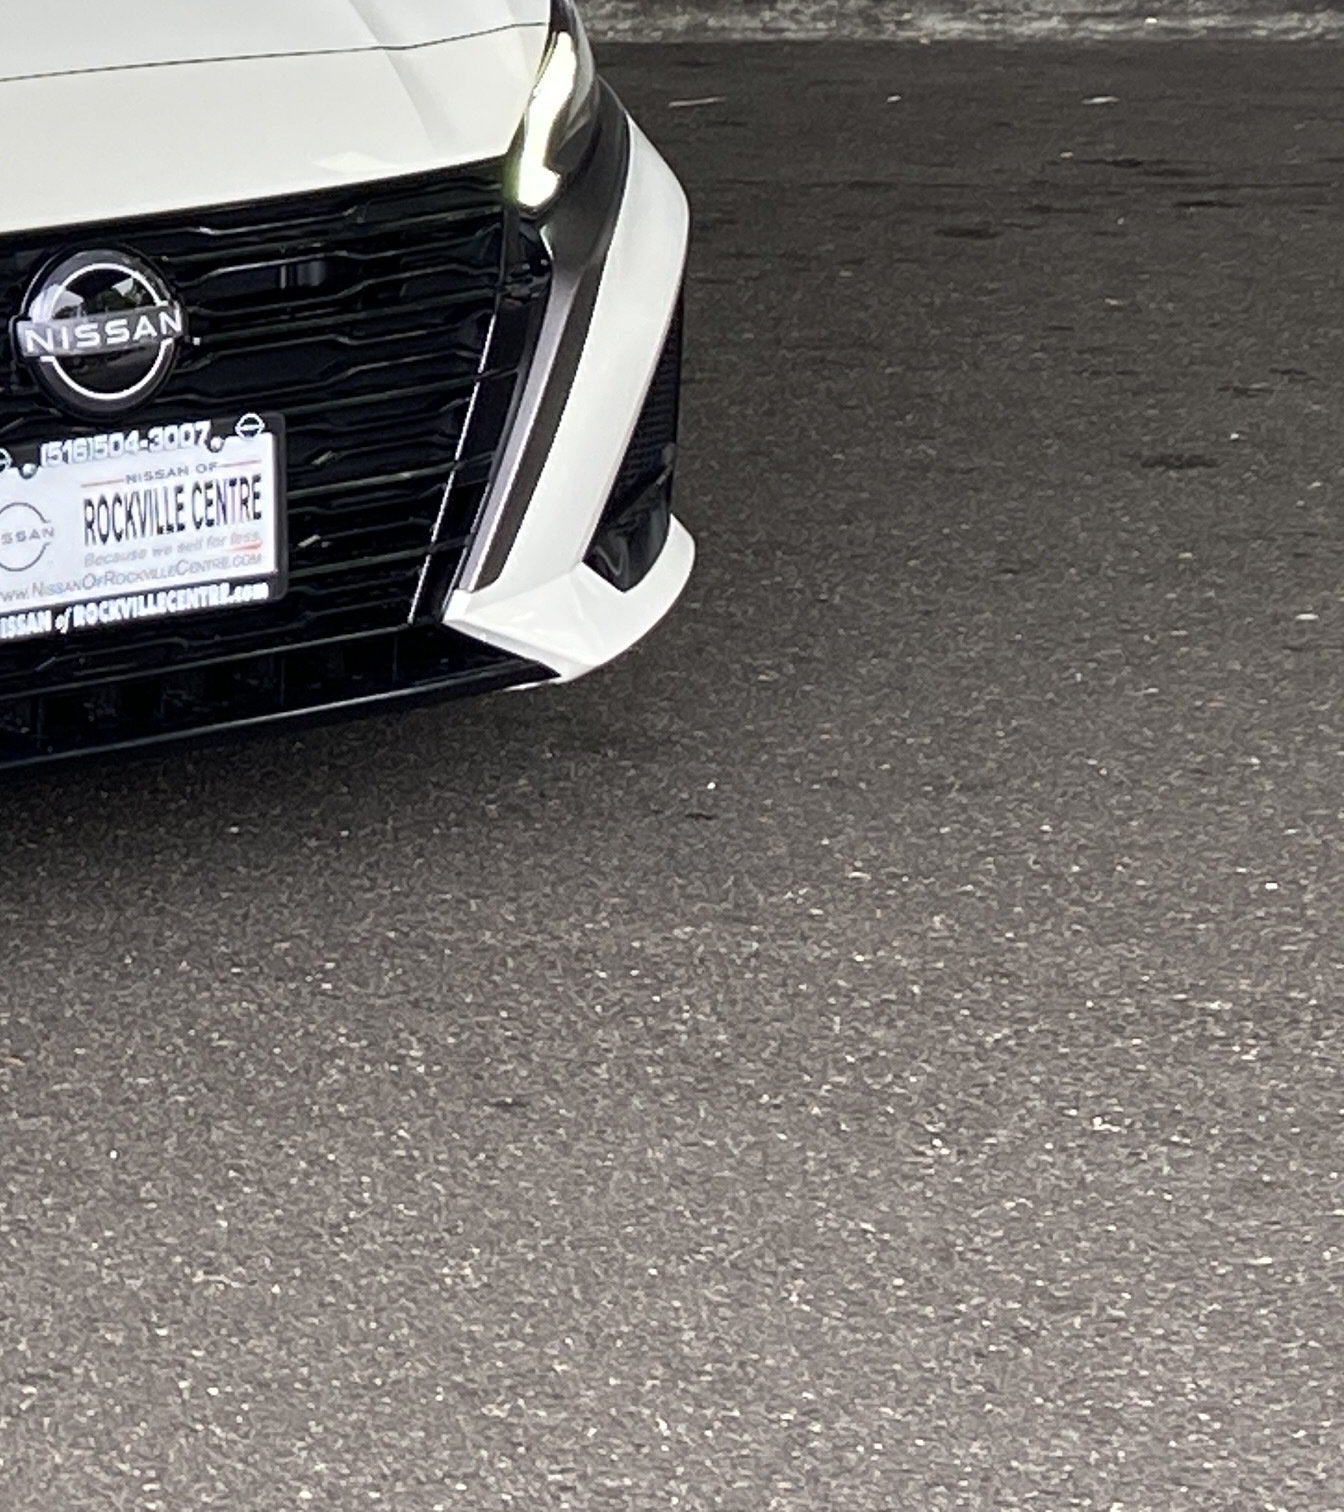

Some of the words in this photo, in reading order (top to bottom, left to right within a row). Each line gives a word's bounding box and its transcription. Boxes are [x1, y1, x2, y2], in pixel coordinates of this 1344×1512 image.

[24, 307, 183, 354] NISSAN
[125, 464, 189, 485] NISSAN
[82, 483, 186, 547] ROCKVILLE
[191, 473, 263, 531] CENTRE
[83, 544, 148, 568] Because
[54, 606, 73, 634] of
